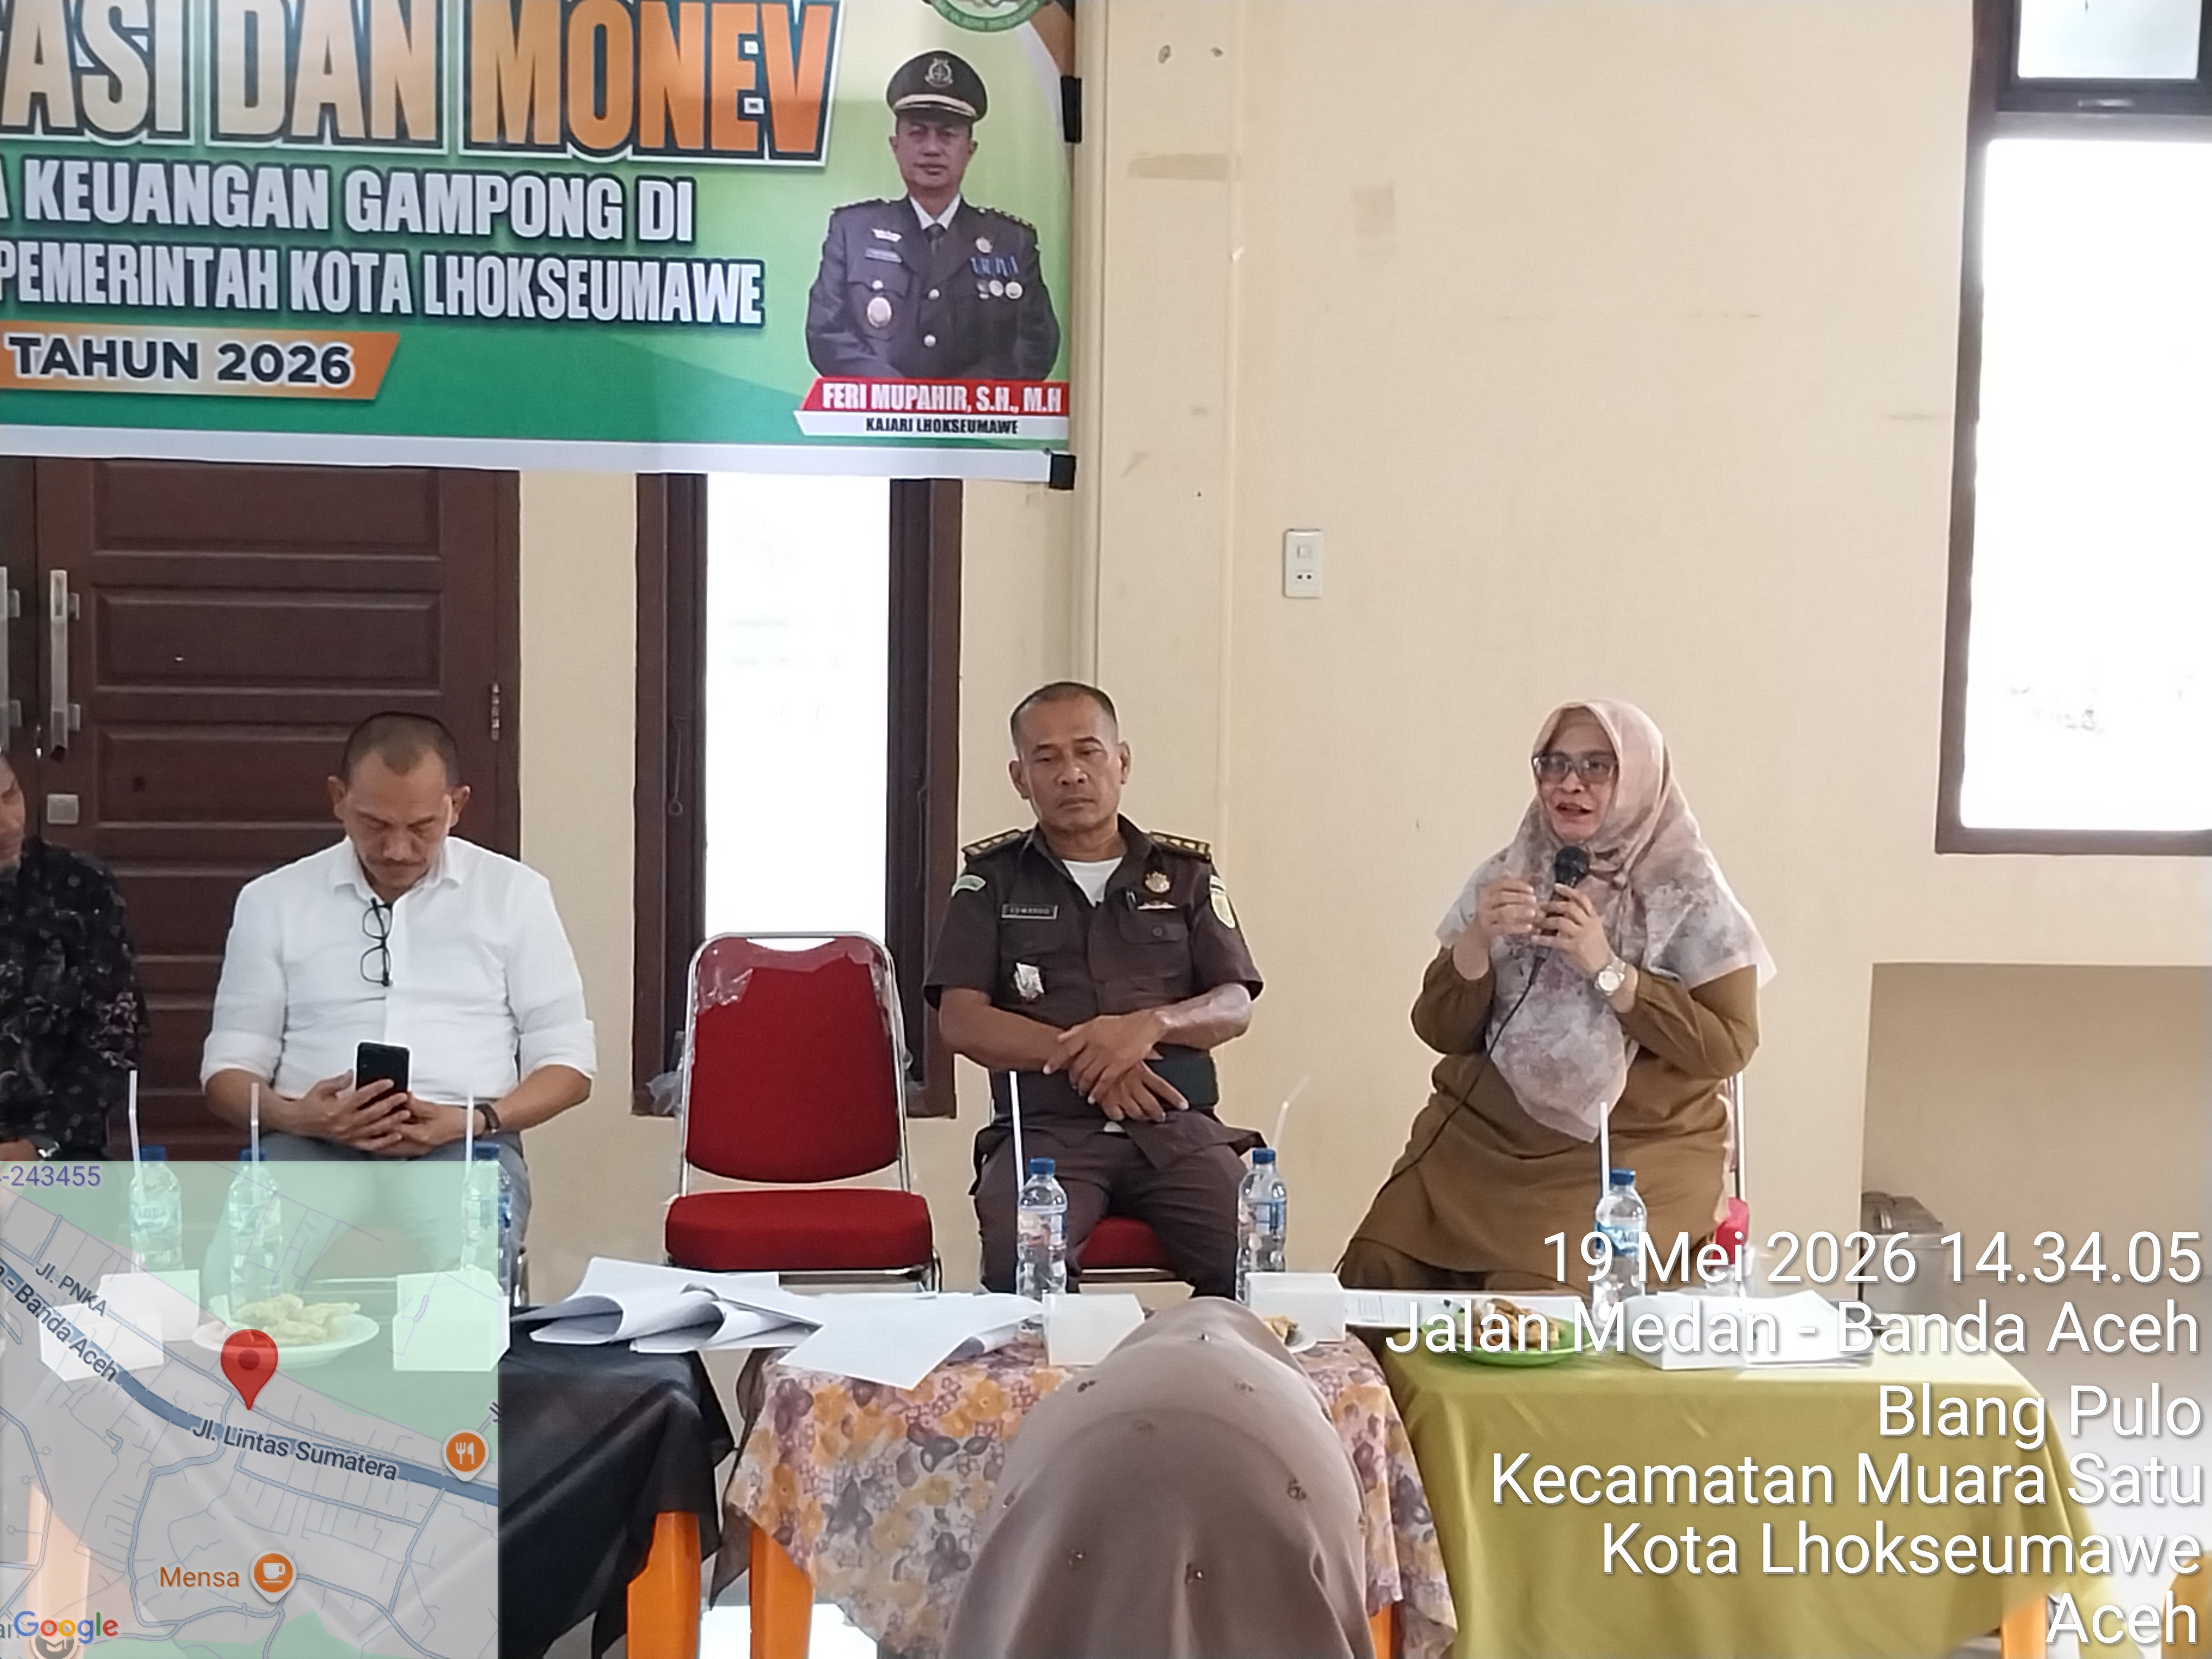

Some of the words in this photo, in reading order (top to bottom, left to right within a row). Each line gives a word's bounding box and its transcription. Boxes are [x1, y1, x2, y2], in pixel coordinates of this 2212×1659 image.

[217, 0, 437, 142] DAN
[470, 0, 832, 153] MONEV
[25, 159, 329, 230] KEUANGAN
[345, 169, 623, 240] GAMPONG
[639, 179, 693, 242] DI
[290, 250, 413, 314] KOTA
[423, 254, 762, 324] LHOKSEUMAWE
[9, 336, 198, 380] TAHUN
[217, 343, 351, 384] 2026
[822, 383, 867, 409] FERI
[871, 384, 972, 413] MUPAHIR,
[976, 385, 1019, 414] S.H.,
[1023, 387, 1062, 413] M.H
[866, 417, 913, 432] KAJARI
[917, 419, 1018, 434] LHOKSEUMAWE
